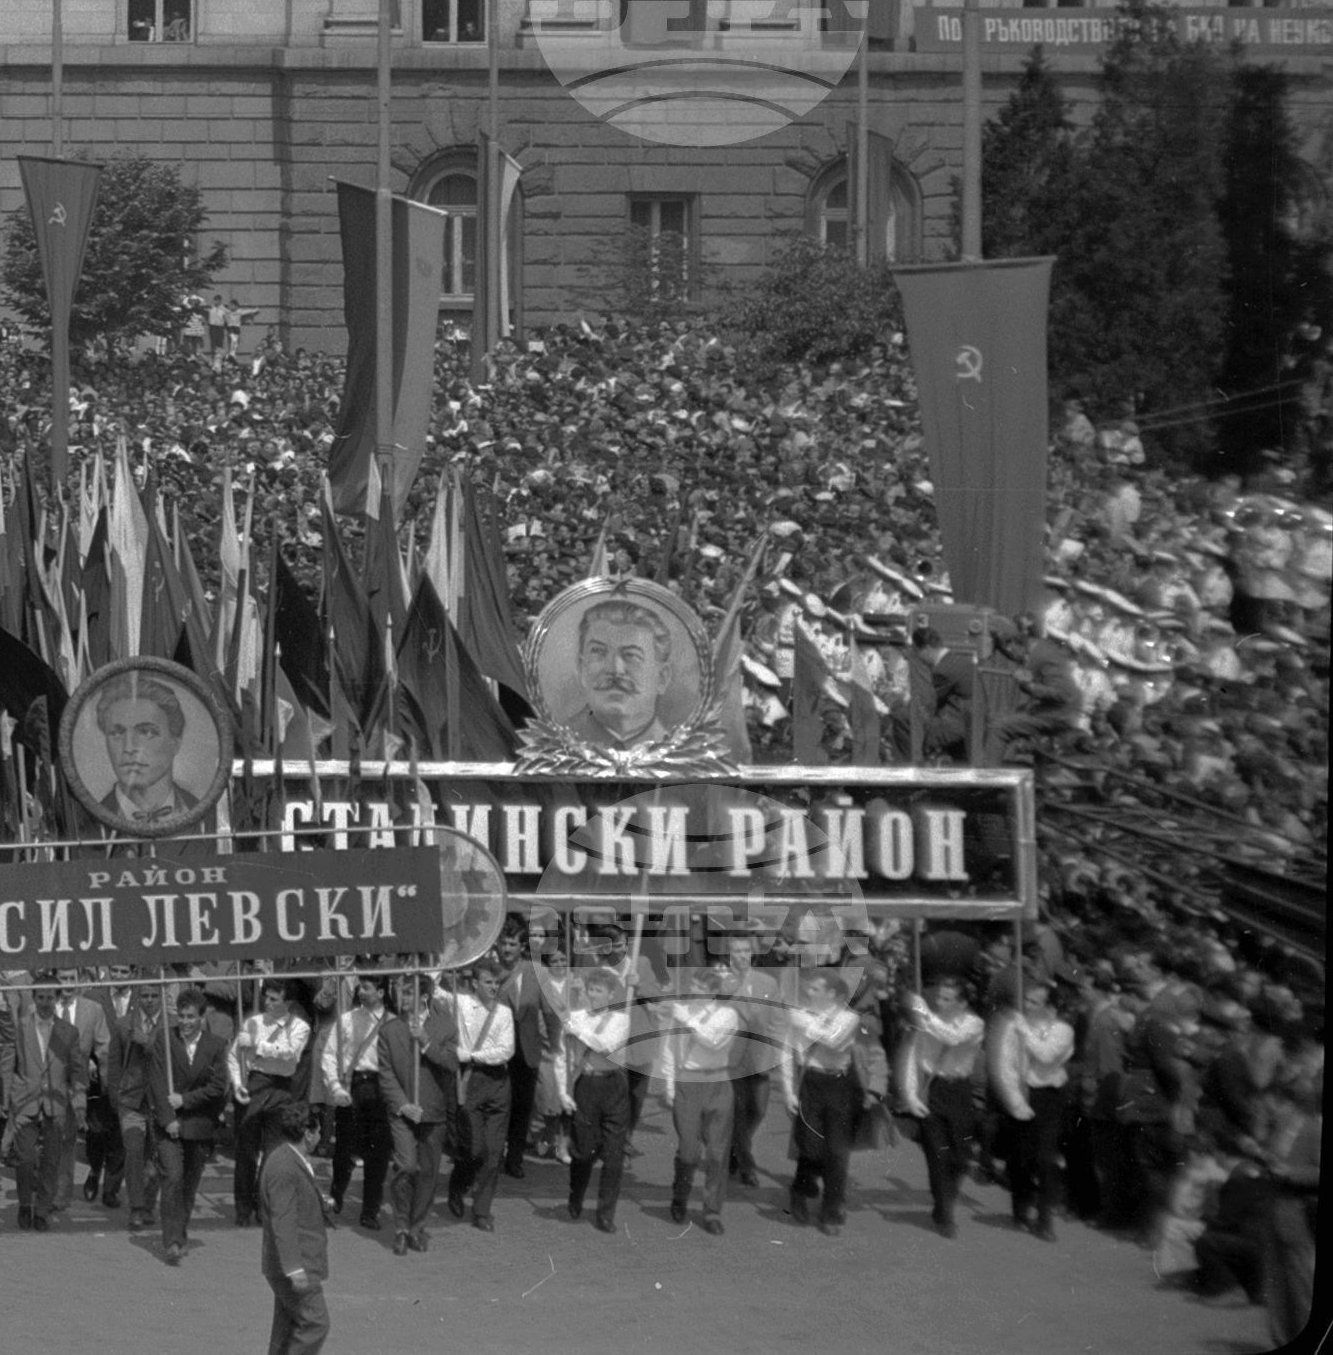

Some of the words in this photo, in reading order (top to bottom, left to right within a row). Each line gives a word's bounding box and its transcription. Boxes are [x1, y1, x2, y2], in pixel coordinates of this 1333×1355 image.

[727, 795, 971, 881] РАЙОН
[88, 865, 229, 890] РАЙОН
[142, 884, 418, 949] ЛЕВСКИ“
